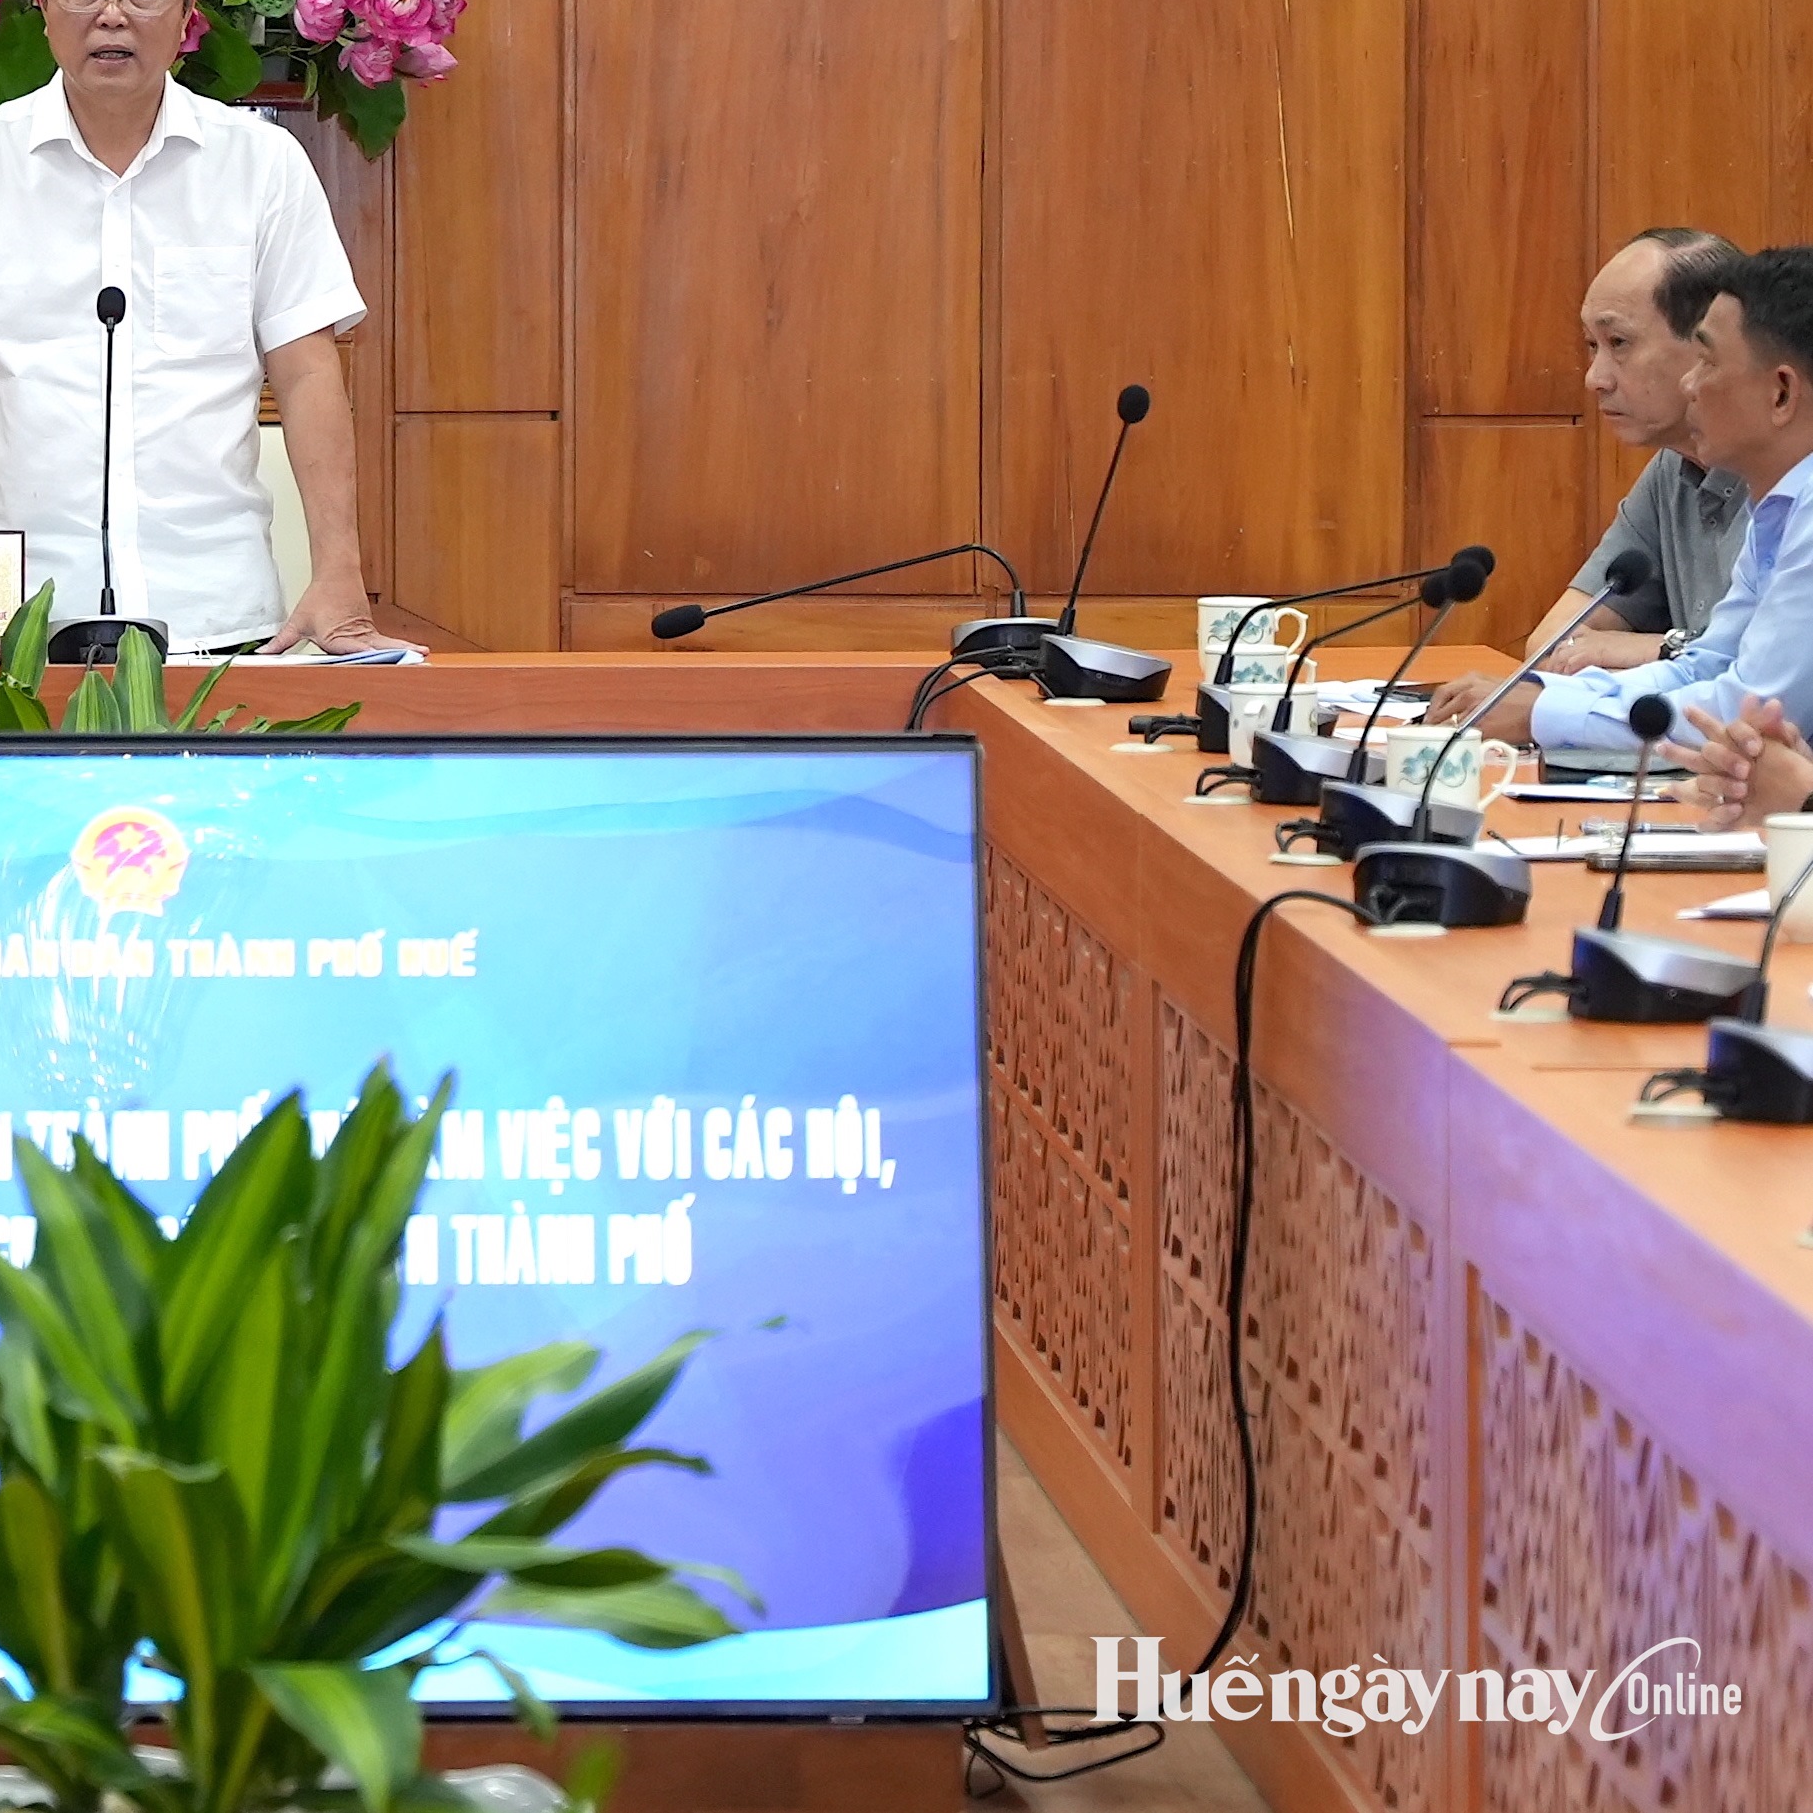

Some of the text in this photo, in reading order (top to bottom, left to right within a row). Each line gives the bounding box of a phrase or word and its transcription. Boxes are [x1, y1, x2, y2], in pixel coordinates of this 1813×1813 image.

[166, 931, 295, 978] THÀNH
[307, 928, 386, 978] PHỐ
[398, 928, 479, 978] HUẾ
[497, 1094, 601, 1195] VIỆC
[613, 1094, 692, 1180] VỚI
[703, 1094, 793, 1180] CÁC
[805, 1093, 896, 1194] HỘI,
[449, 1199, 595, 1285] THÀNH
[607, 1192, 696, 1286] PHỐ
